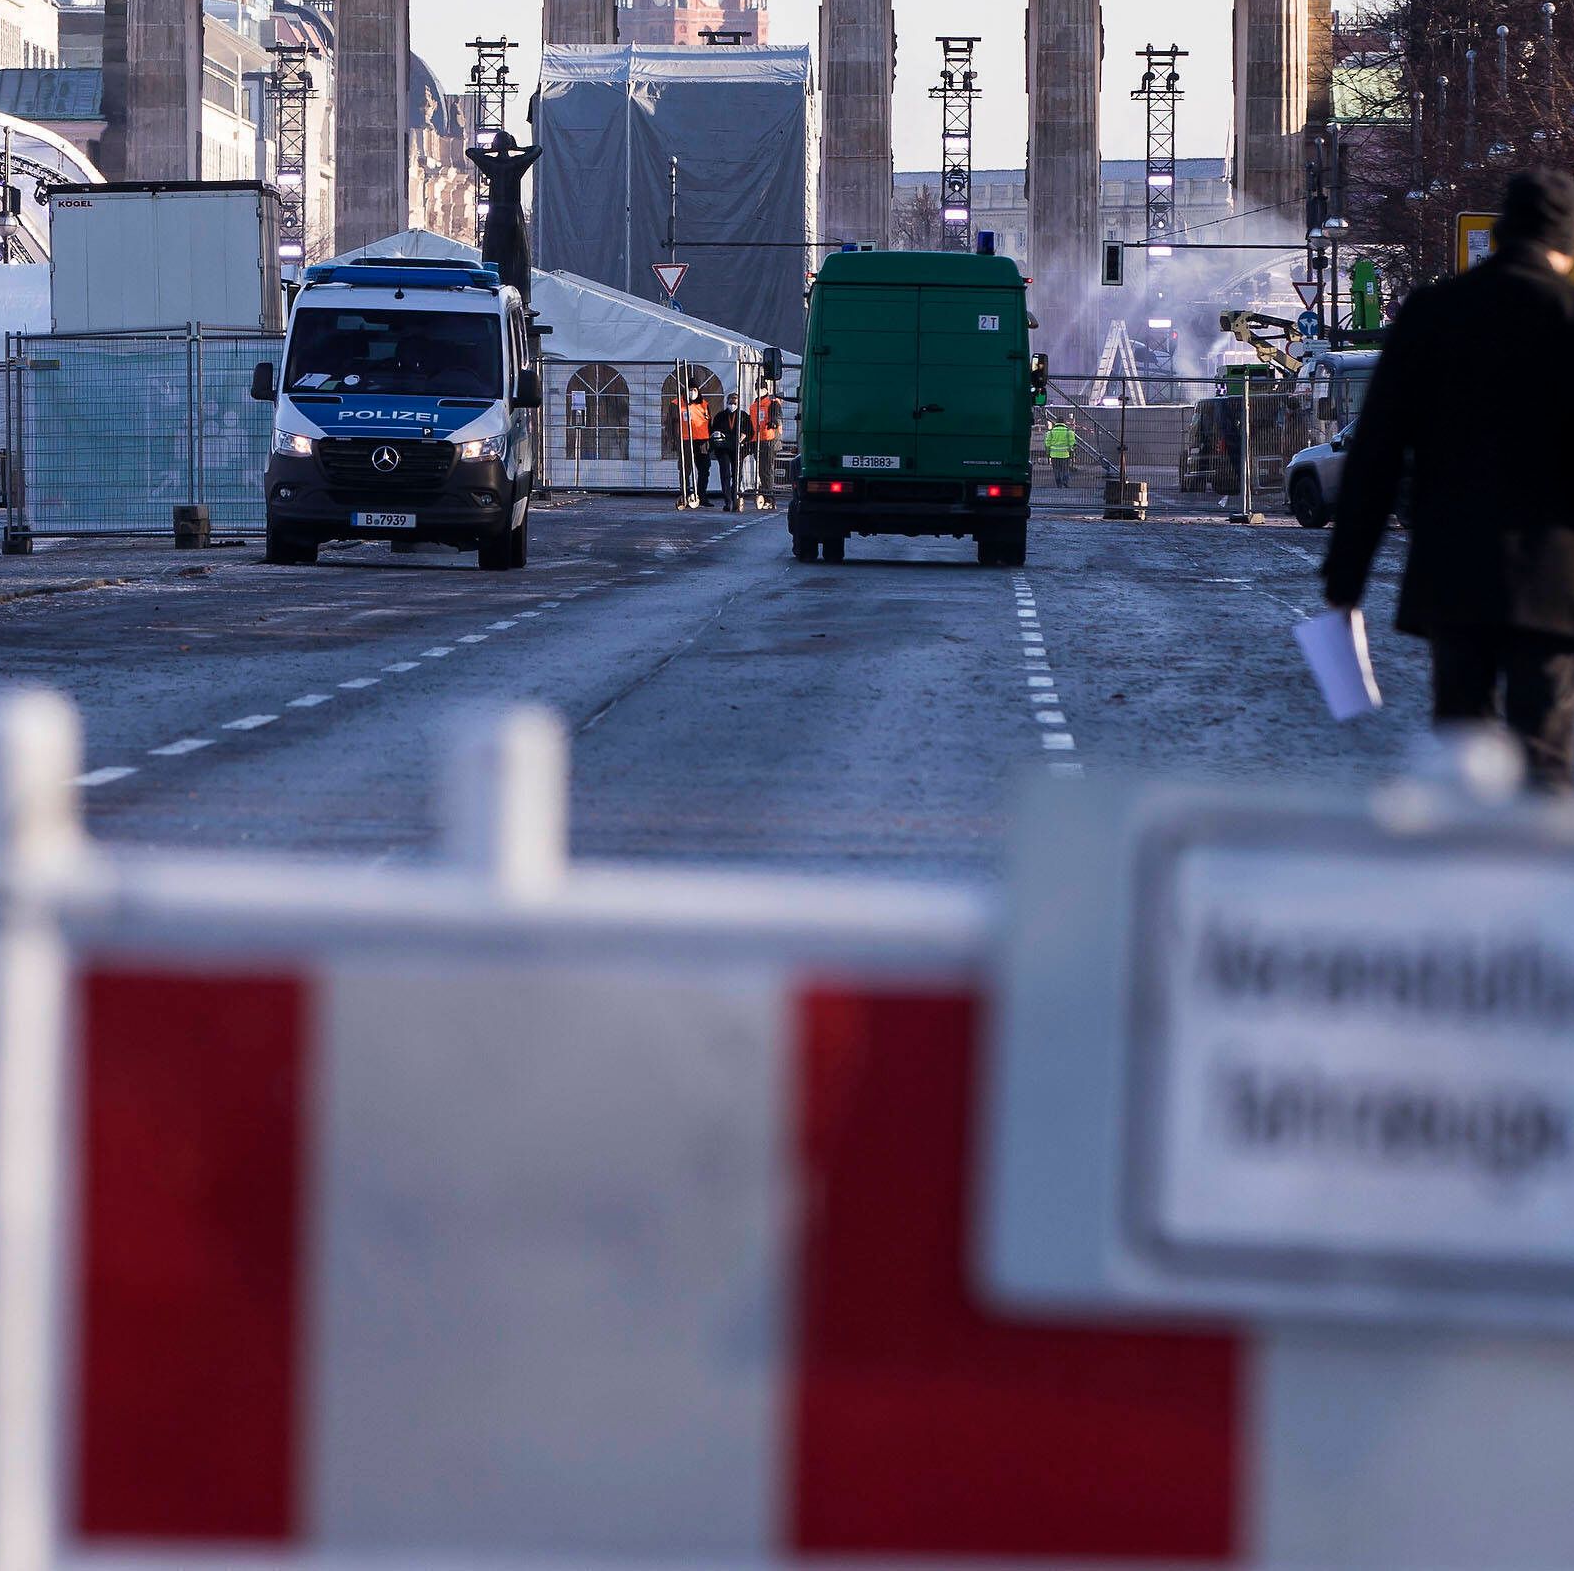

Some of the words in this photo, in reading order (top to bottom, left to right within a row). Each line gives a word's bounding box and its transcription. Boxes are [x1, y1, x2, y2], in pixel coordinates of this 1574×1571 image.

[981, 316, 987, 329] 2
[990, 316, 997, 329] T
[338, 410, 439, 423] POLIZEI
[380, 514, 406, 526] 7939
